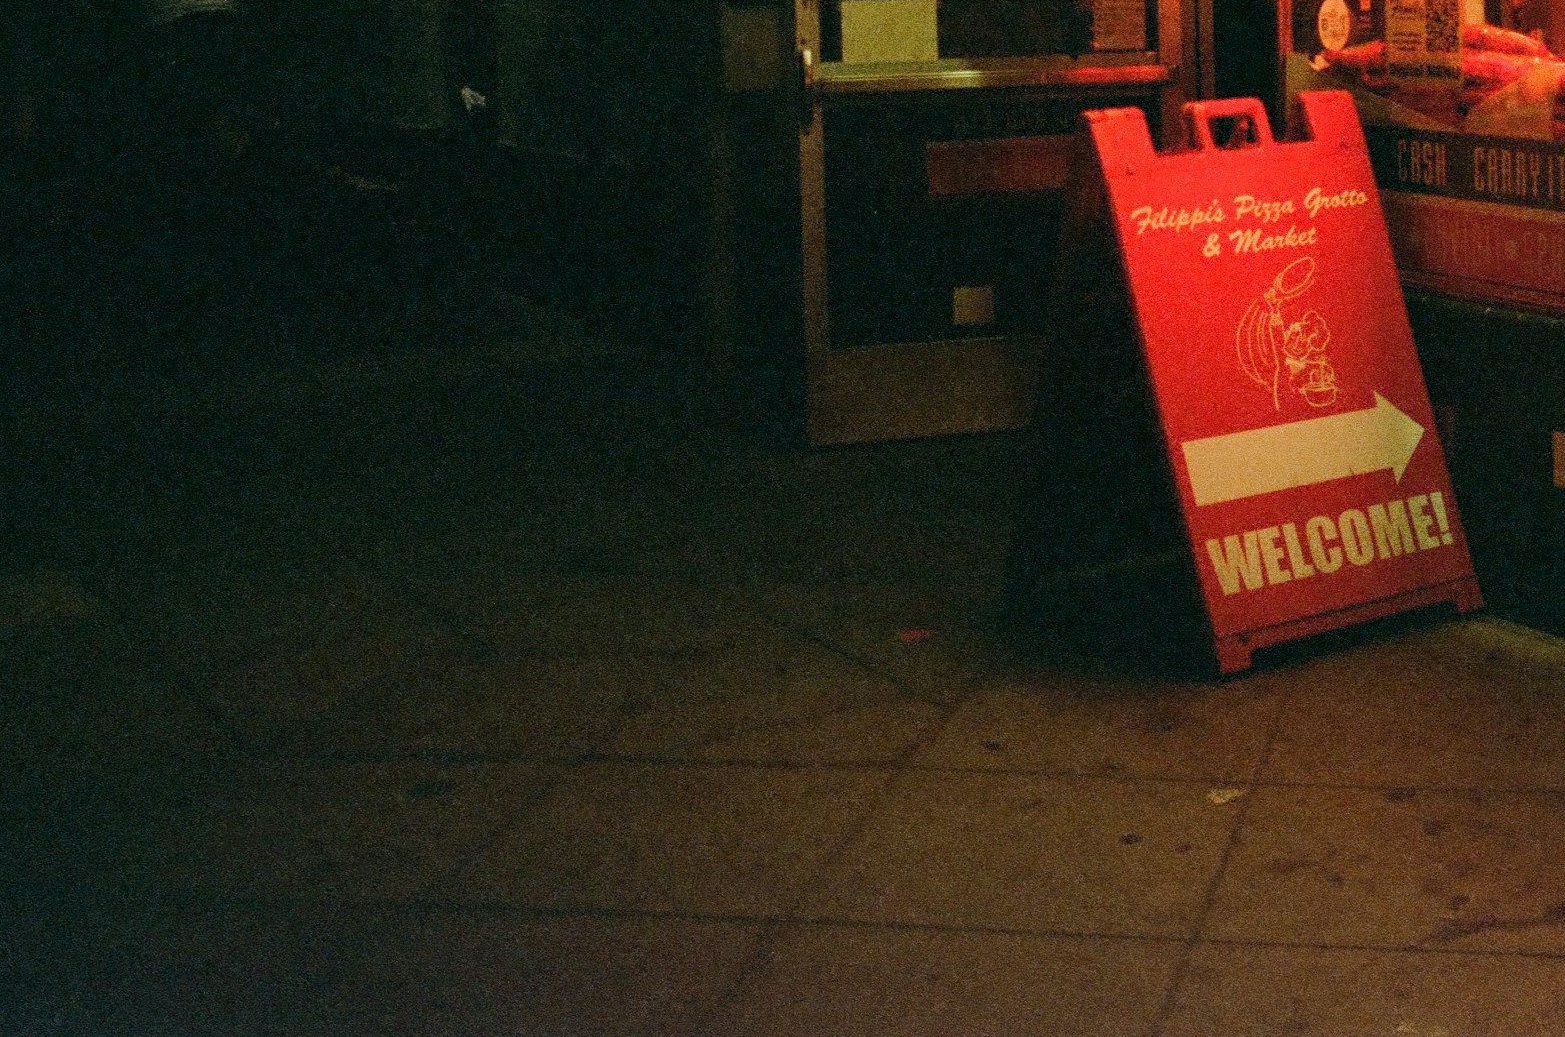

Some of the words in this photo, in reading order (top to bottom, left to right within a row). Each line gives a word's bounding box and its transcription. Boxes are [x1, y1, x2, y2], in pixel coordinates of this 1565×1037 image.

[1473, 146, 1541, 198] CARRY
[1131, 199, 1225, 236] Filippi's
[1233, 194, 1296, 228] Pizza
[1304, 187, 1368, 214] Grotto
[1202, 232, 1222, 259] &
[1228, 225, 1318, 256] Market
[1205, 491, 1455, 597] WELCOME!
